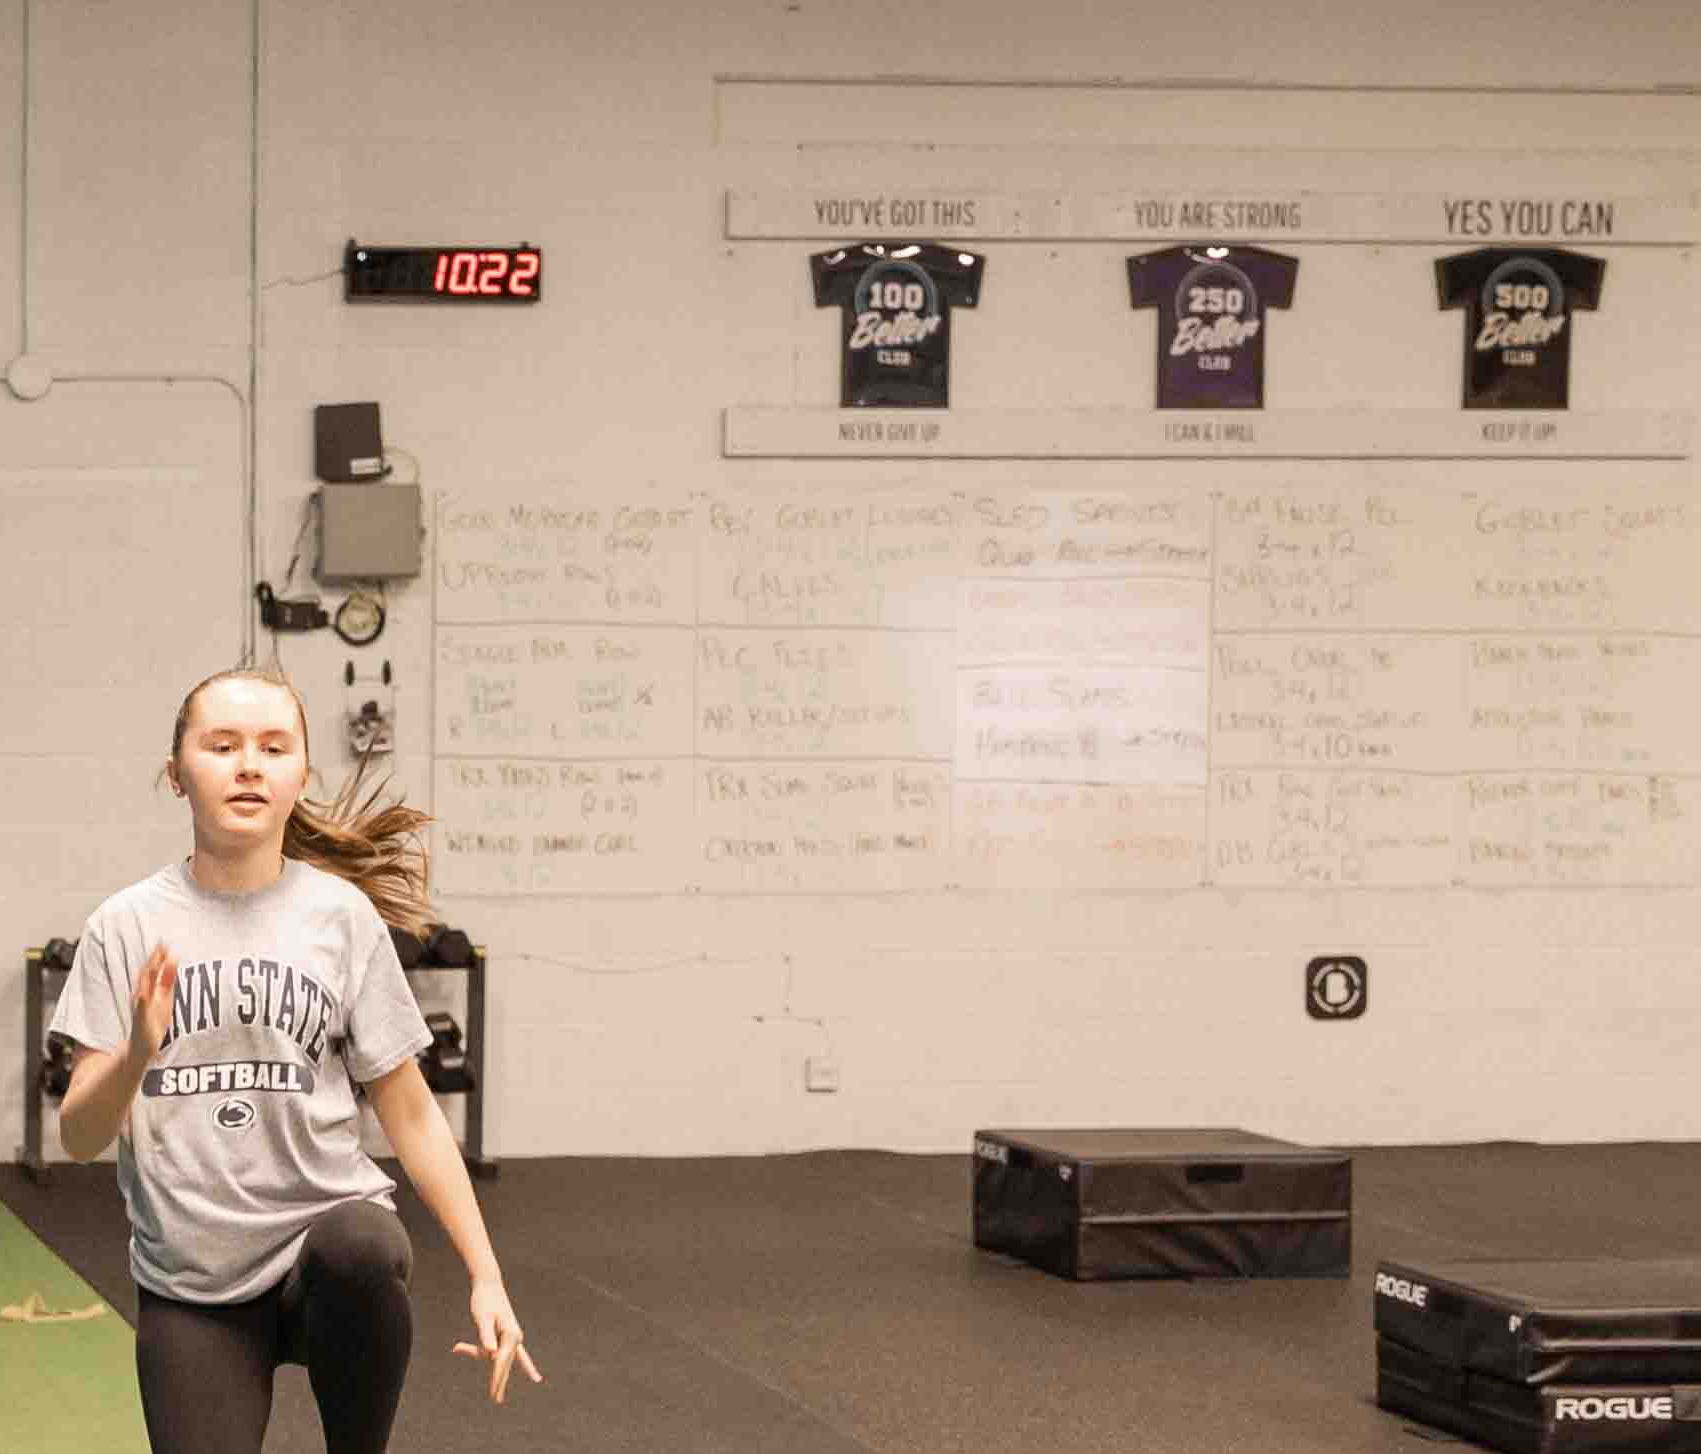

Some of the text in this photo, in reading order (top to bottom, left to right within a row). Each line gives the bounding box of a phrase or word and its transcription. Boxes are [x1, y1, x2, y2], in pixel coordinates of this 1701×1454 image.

[813, 199, 976, 228] YOU'VE GOT THIS
[1134, 200, 1302, 230] YOU ARE STRONG
[1444, 200, 1614, 236] YES YOU CAN
[868, 281, 925, 310] 100
[1188, 286, 1244, 313] 250
[1494, 282, 1549, 310] 500
[849, 310, 942, 350] Better
[1169, 315, 1261, 356] Better
[1473, 310, 1566, 351] Better
[838, 422, 884, 442] NEVER
[887, 422, 920, 442] GIVE
[237, 956, 334, 1065] STATE
[160, 1062, 303, 1095] SOFTBALL
[1374, 1271, 1430, 1308] ROGUE
[1554, 1396, 1674, 1422] ROGUE
